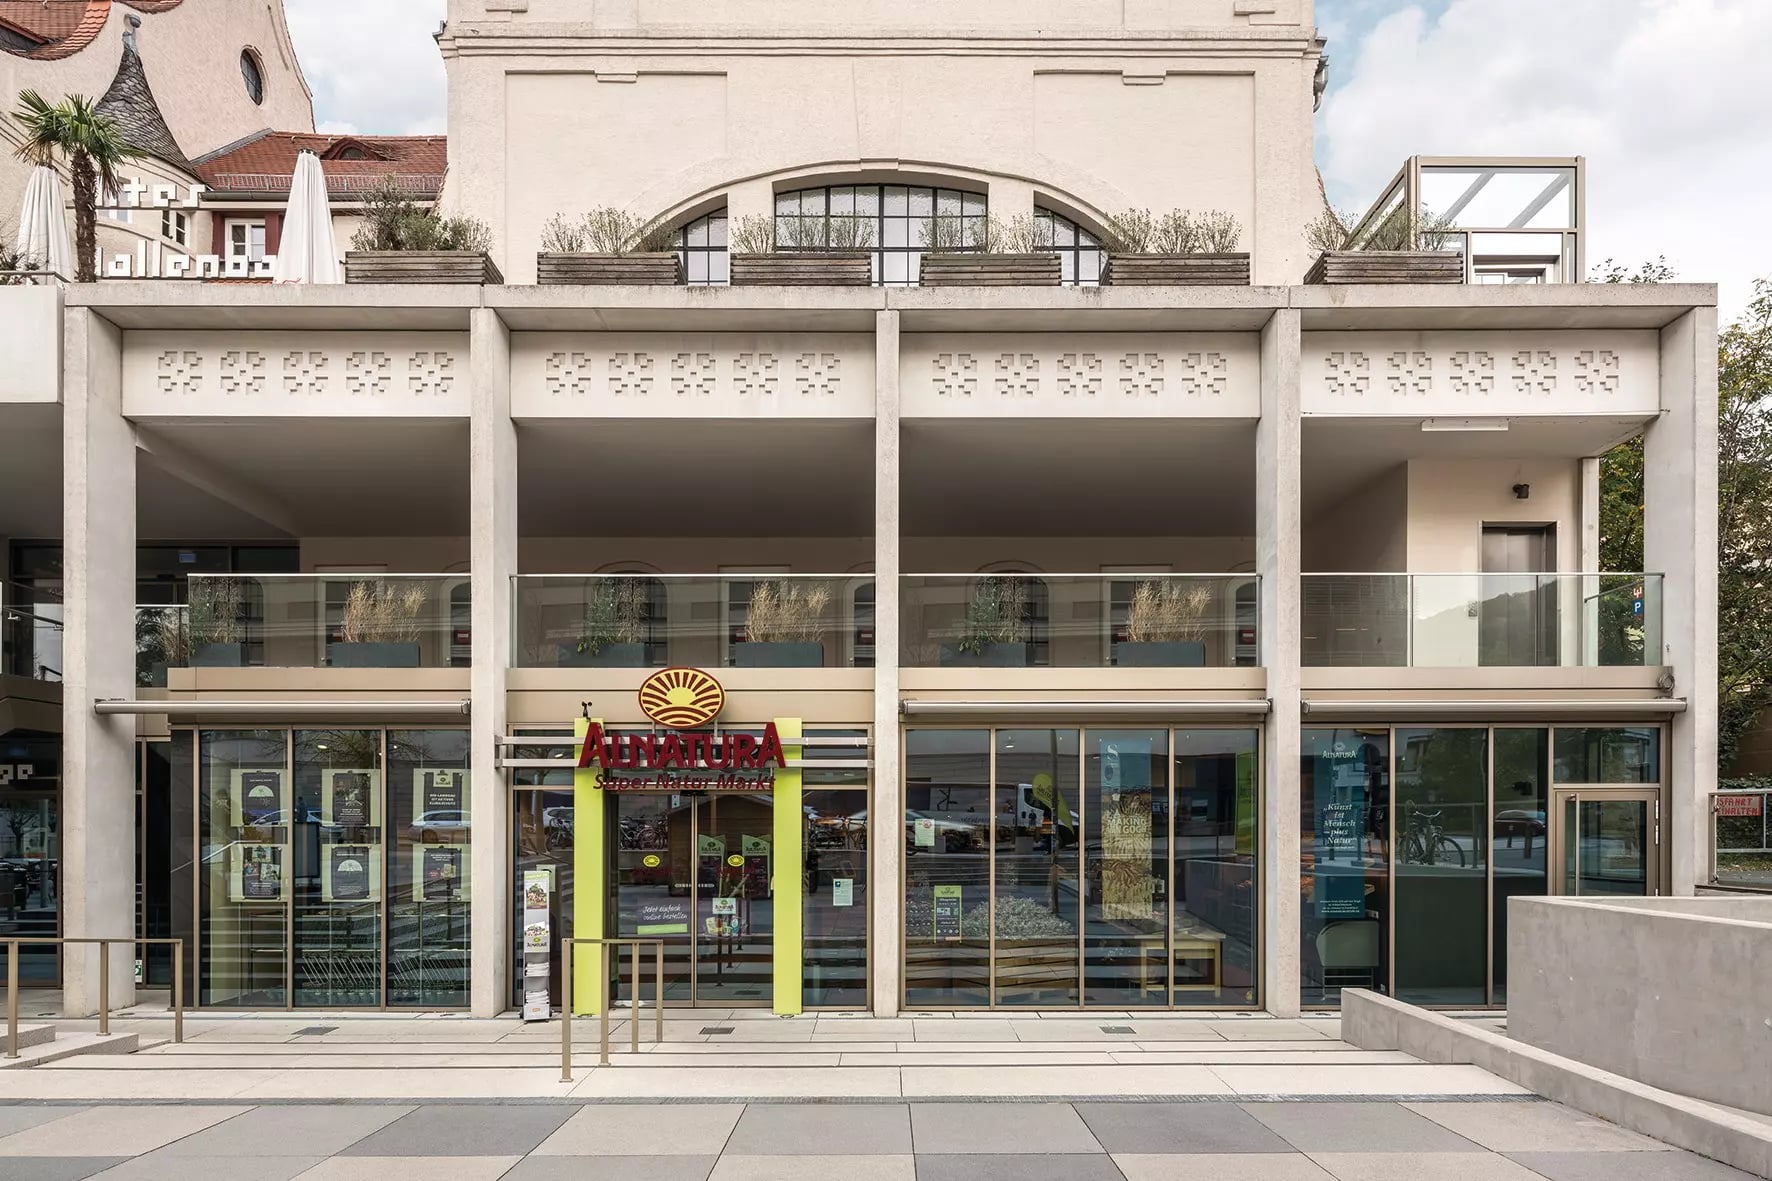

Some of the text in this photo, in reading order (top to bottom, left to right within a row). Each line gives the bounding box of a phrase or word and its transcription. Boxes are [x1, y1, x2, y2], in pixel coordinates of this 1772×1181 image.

[1634, 601, 1641, 613] P
[578, 722, 787, 769] ALNATURA
[593, 773, 776, 794] Super Natur Markt
[1334, 811, 1345, 819] ist
[1107, 818, 1148, 826] MAKING
[1323, 819, 1356, 827] Mensch
[1122, 825, 1148, 834] GOGH
[1330, 828, 1349, 838] plus
